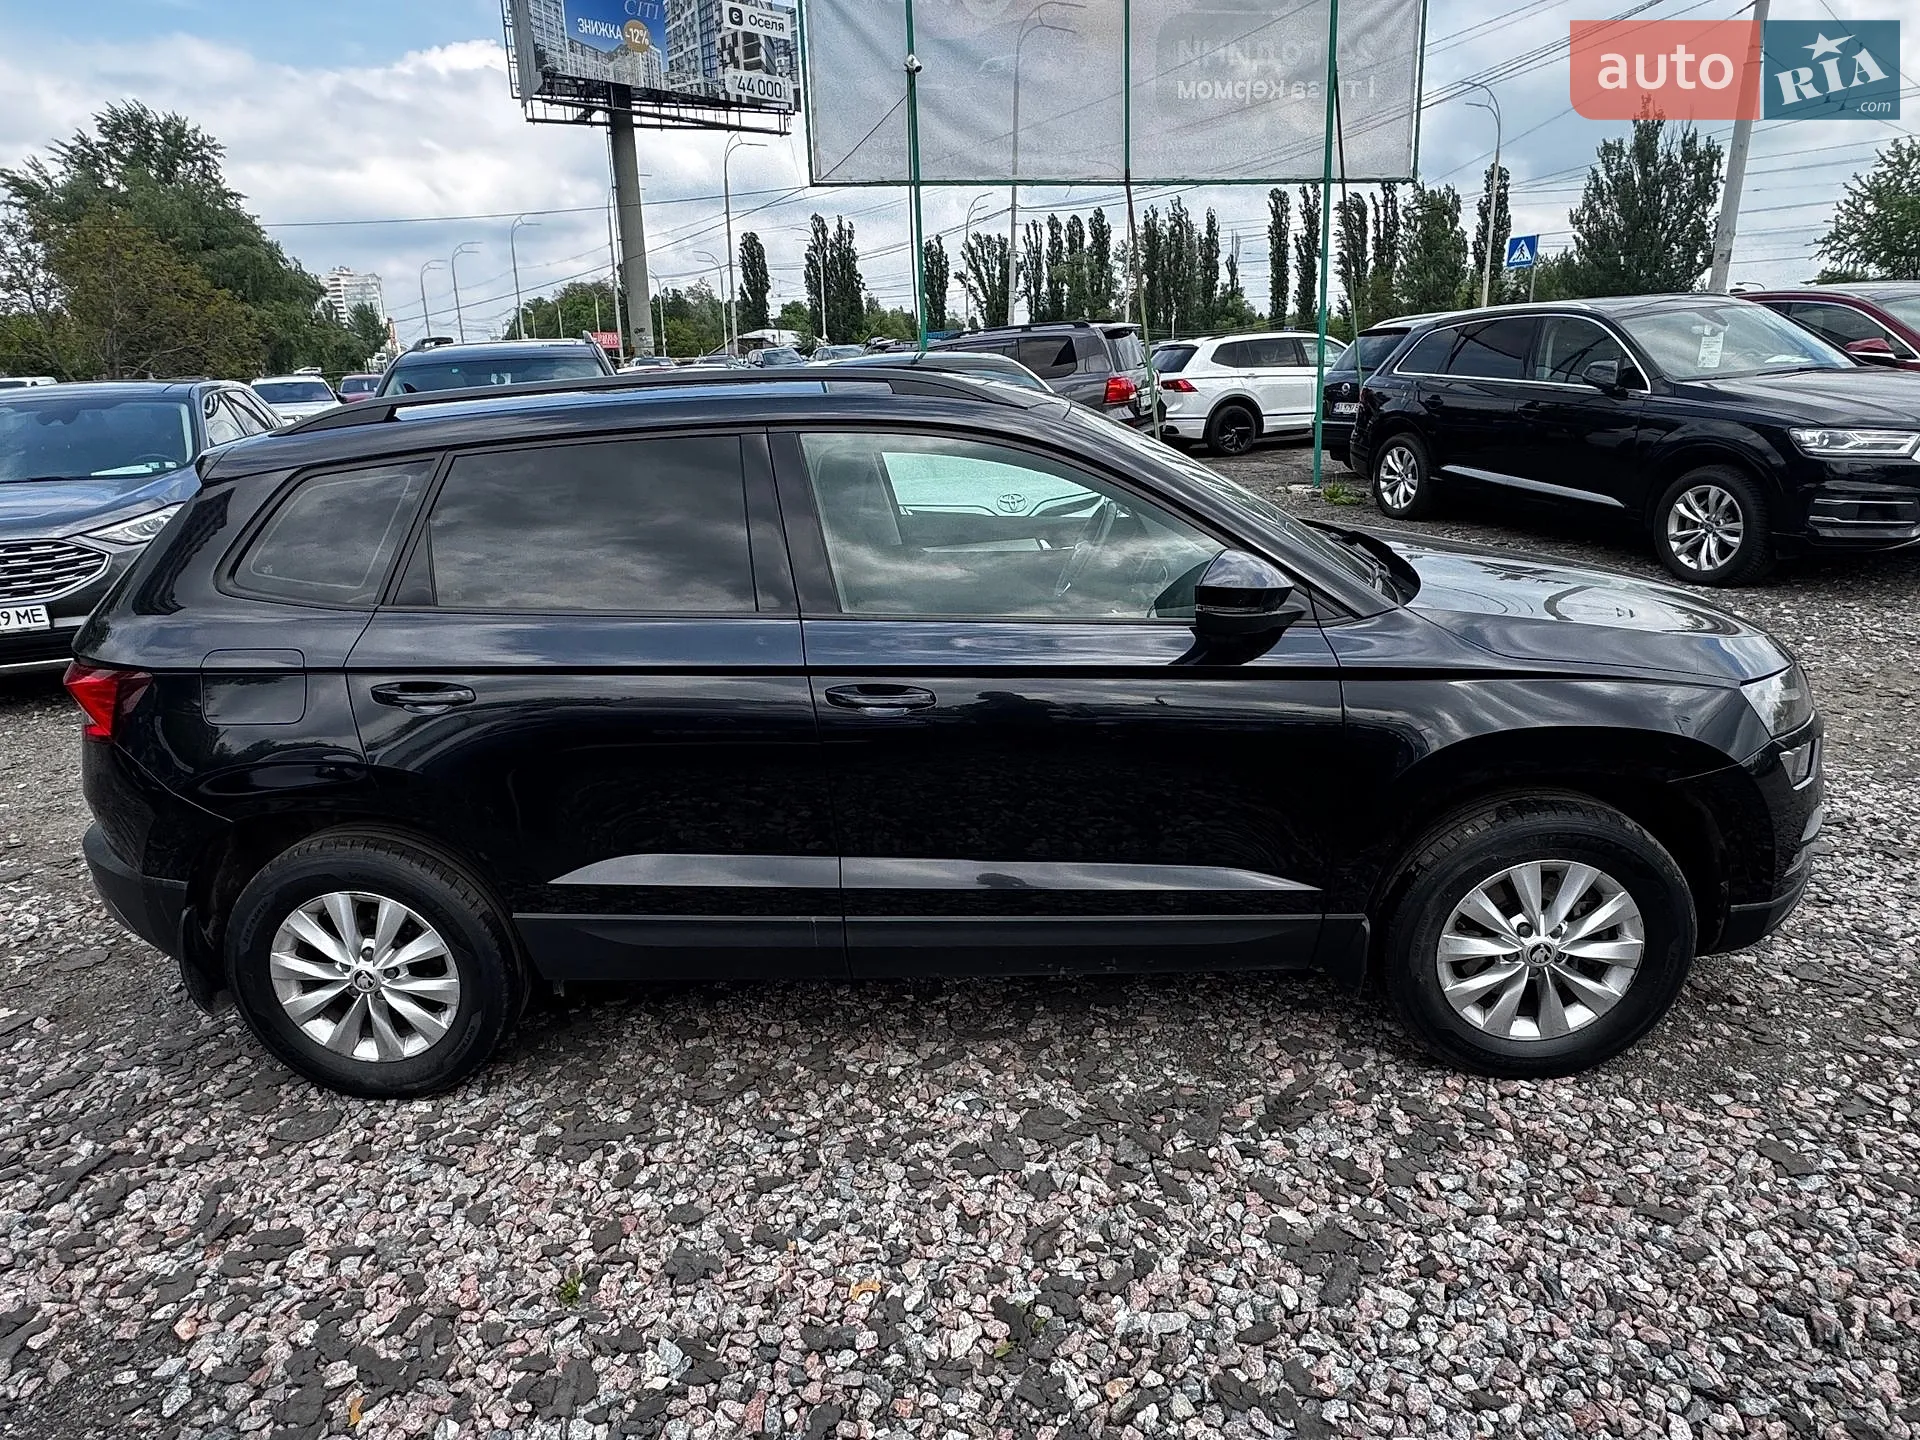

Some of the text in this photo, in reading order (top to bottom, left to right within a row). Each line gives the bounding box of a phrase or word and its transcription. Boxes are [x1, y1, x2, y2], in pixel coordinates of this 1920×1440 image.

[577, 17, 650, 46] ЗНИЖКА -12%
[748, 14, 785, 32] Оселя
[737, 75, 755, 94] 44
[757, 79, 782, 98] 000
[0, 608, 45, 625] 9 ME
